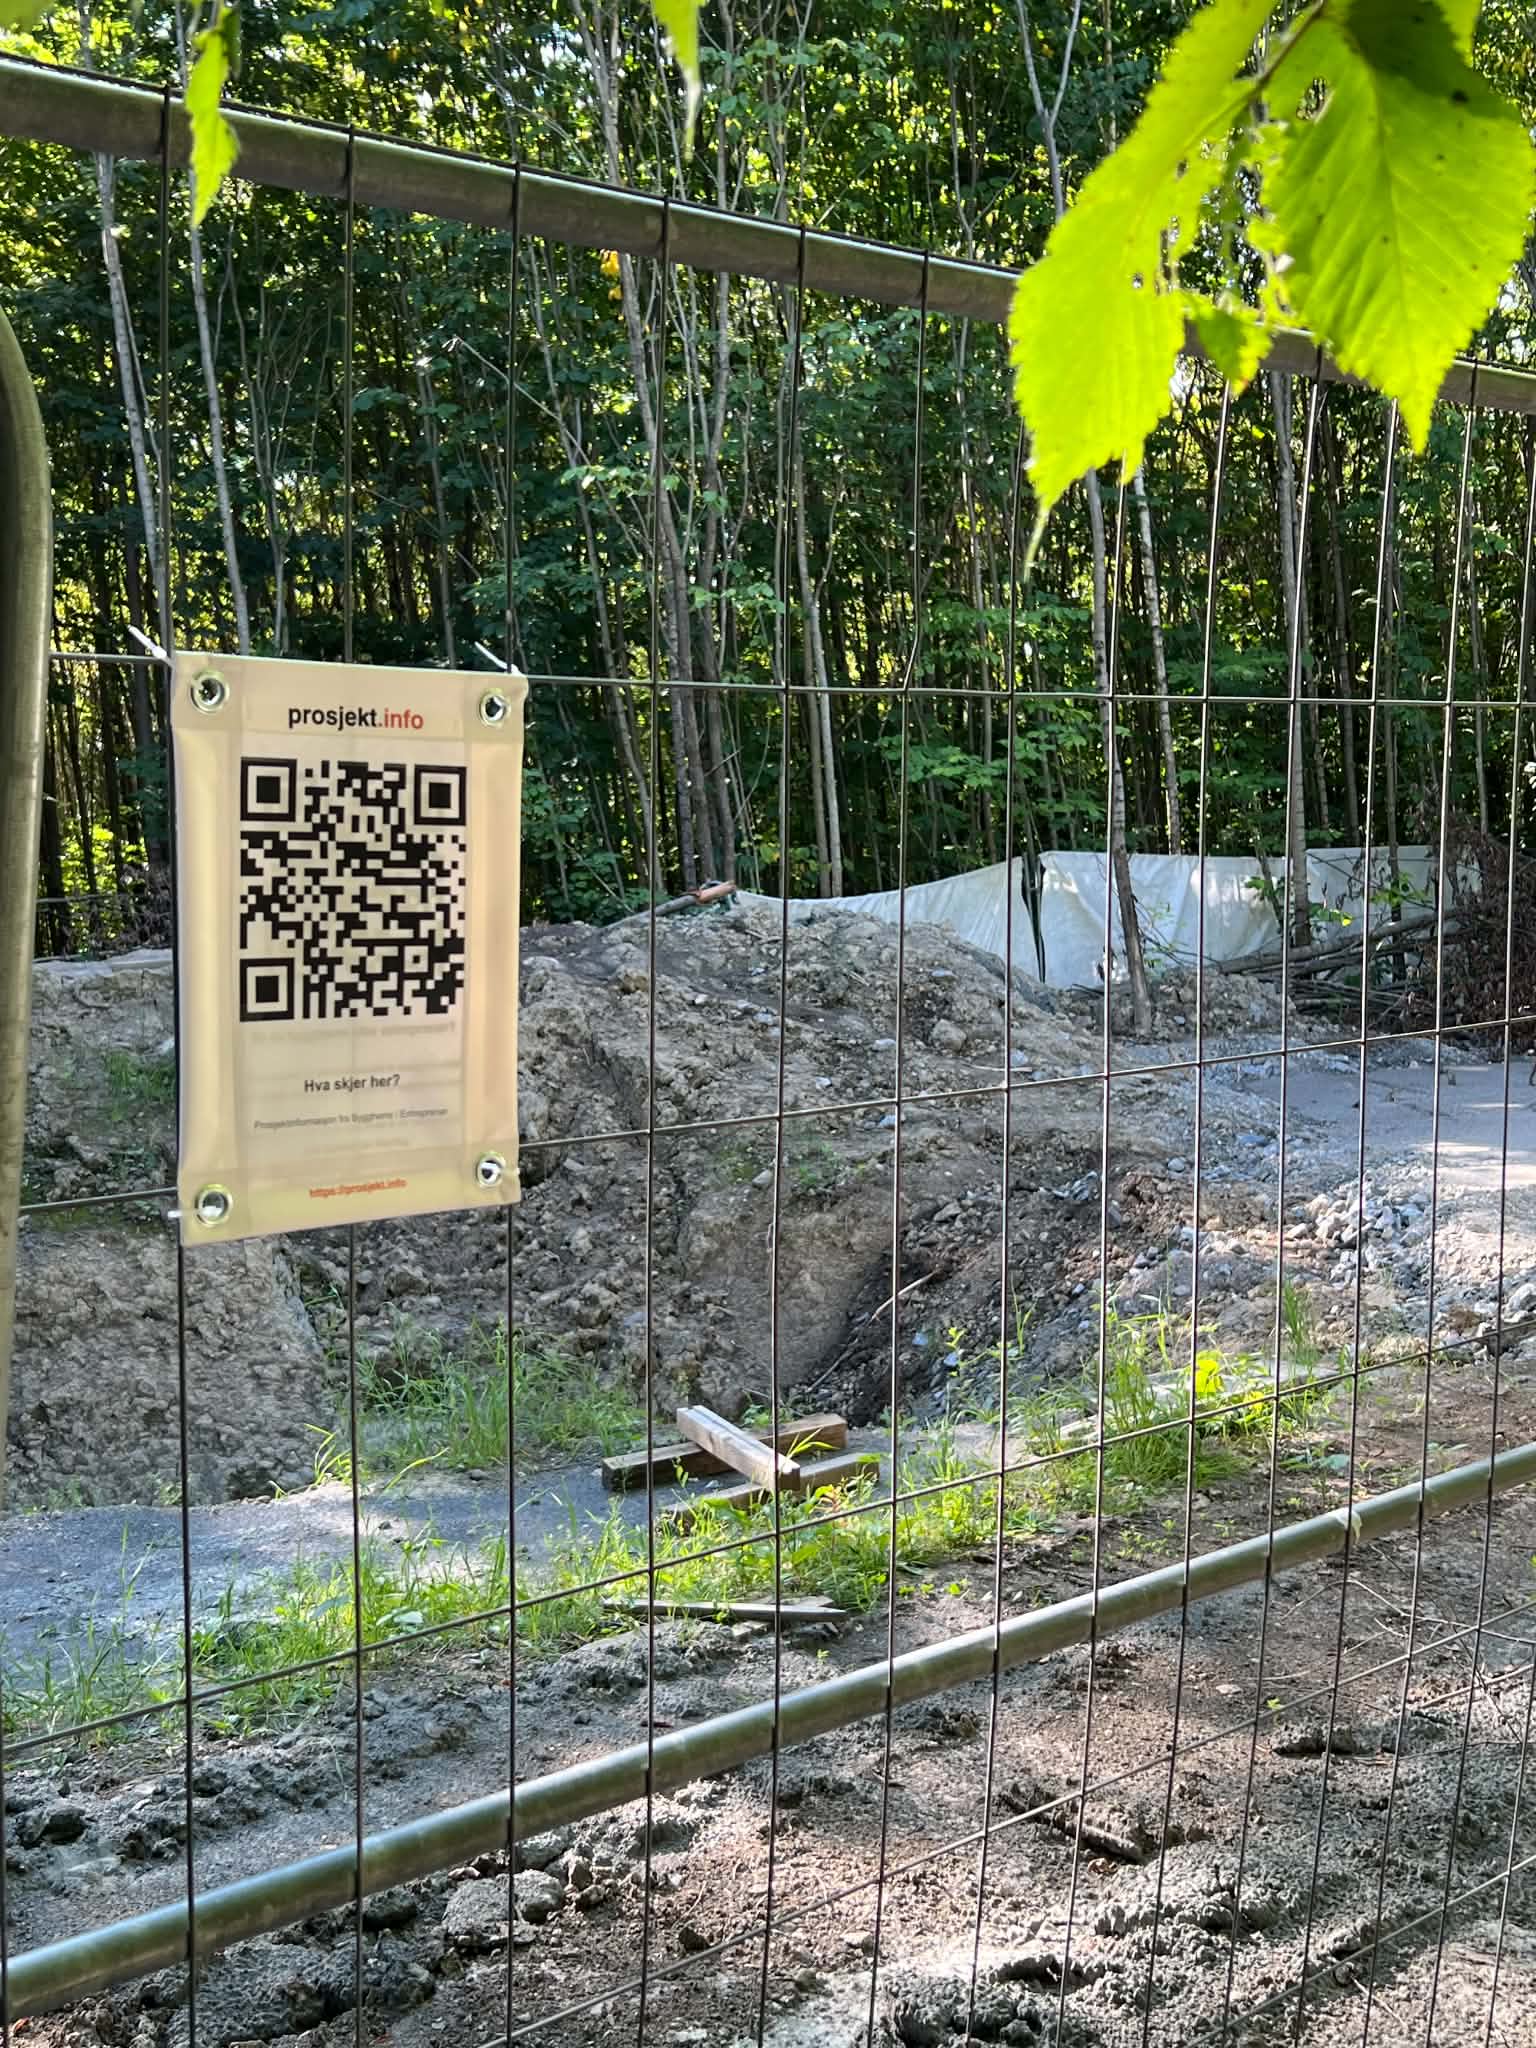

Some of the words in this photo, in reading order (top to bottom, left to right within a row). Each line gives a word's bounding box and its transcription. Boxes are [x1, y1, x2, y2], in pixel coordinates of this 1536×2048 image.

[288, 706, 424, 731] prosjekt.info
[304, 1080, 330, 1092] Hva
[334, 1077, 367, 1092] skjer
[370, 1074, 400, 1088] her?
